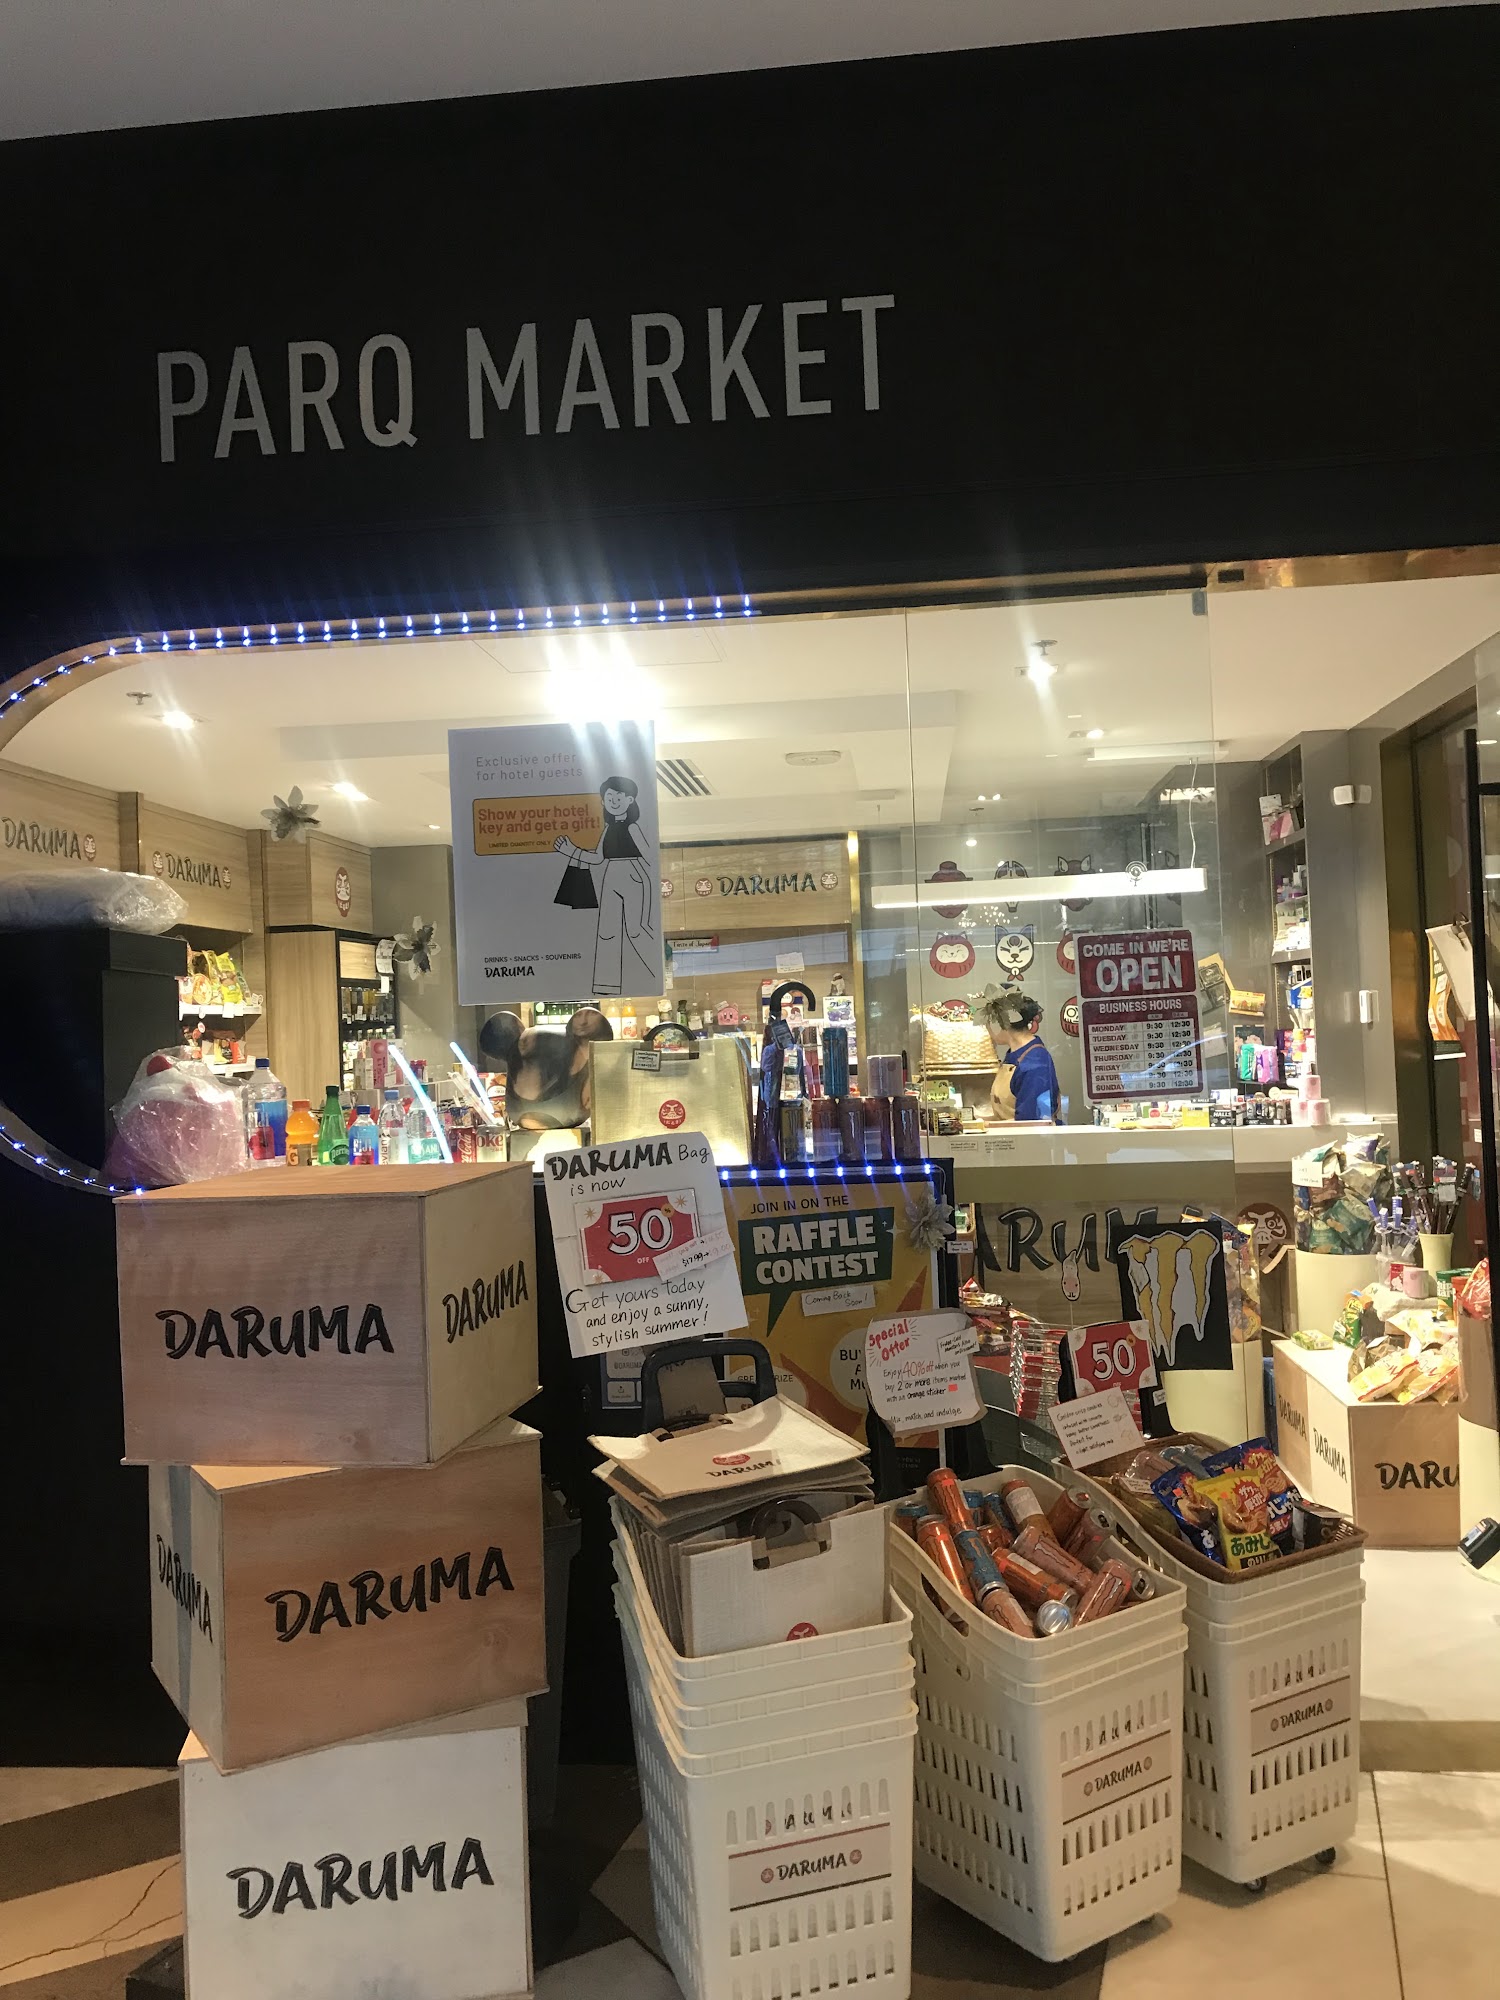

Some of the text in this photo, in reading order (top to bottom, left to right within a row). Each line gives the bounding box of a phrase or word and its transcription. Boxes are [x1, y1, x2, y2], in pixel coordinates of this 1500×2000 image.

[157, 294, 896, 463] PARQ MARKET
[476, 754, 577, 767] Exclusive offer
[476, 767, 583, 781] for hotel guests
[478, 804, 589, 825] Show your hotel
[479, 816, 600, 837] key and get a gift!
[2, 817, 81, 860] DARUMA
[165, 853, 222, 888] DARUMA
[716, 873, 817, 896] DARUMA
[513, 954, 540, 962] SNACKS
[545, 953, 582, 961] SOUVENIRS
[1083, 938, 1190, 957] COME IN WE'RE
[484, 965, 535, 979] DARUMA
[1096, 955, 1183, 993] OPEN
[1099, 999, 1182, 1014] BUSINESS HOURS
[1091, 1025, 1124, 1033] MONDAY
[1093, 1044, 1139, 1052] WEDNESDAY
[1094, 1054, 1133, 1062] THURSDAY
[546, 1142, 710, 1180] DARUMA Bag
[570, 1177, 626, 1196] is now
[751, 1195, 849, 1214] JOIN IN ON THE
[607, 1207, 673, 1255] 50
[752, 1215, 876, 1255] RAFFLE
[756, 1251, 879, 1285] CONTEST
[565, 1288, 608, 1314] Get
[616, 1287, 659, 1308] yours
[805, 1291, 850, 1304] Coming Back
[155, 1260, 529, 1359] DARUMA DARUMA
[586, 1297, 710, 1328] and enjoy a sunny,
[592, 1329, 639, 1348] stylish
[869, 1319, 909, 1349] Special
[882, 1338, 910, 1361] Offer
[1091, 1338, 1136, 1380] 50
[774, 1375, 794, 1383] RIZE
[883, 1367, 902, 1380] Enjoy
[902, 1361, 925, 1377] 40%
[926, 1361, 934, 1372] off
[950, 1362, 961, 1370] you
[885, 1382, 895, 1392] buy
[897, 1381, 902, 1391] 2
[914, 1378, 931, 1387] more
[932, 1376, 948, 1384] items
[886, 1394, 898, 1403] with
[907, 1390, 925, 1400] orange
[926, 1387, 946, 1396] sticker
[924, 1410, 935, 1418] and
[936, 1407, 962, 1418] indulge
[1279, 1394, 1307, 1441] DARUMA
[1313, 1428, 1347, 1483] DARUMA
[156, 1534, 514, 1643] DARUMA DARUMA
[1280, 1702, 1324, 1728] DARUMA
[1094, 1761, 1142, 1791] DARUMA
[776, 1852, 847, 1880] DARUMA
[226, 1837, 494, 1919] DARUMA
